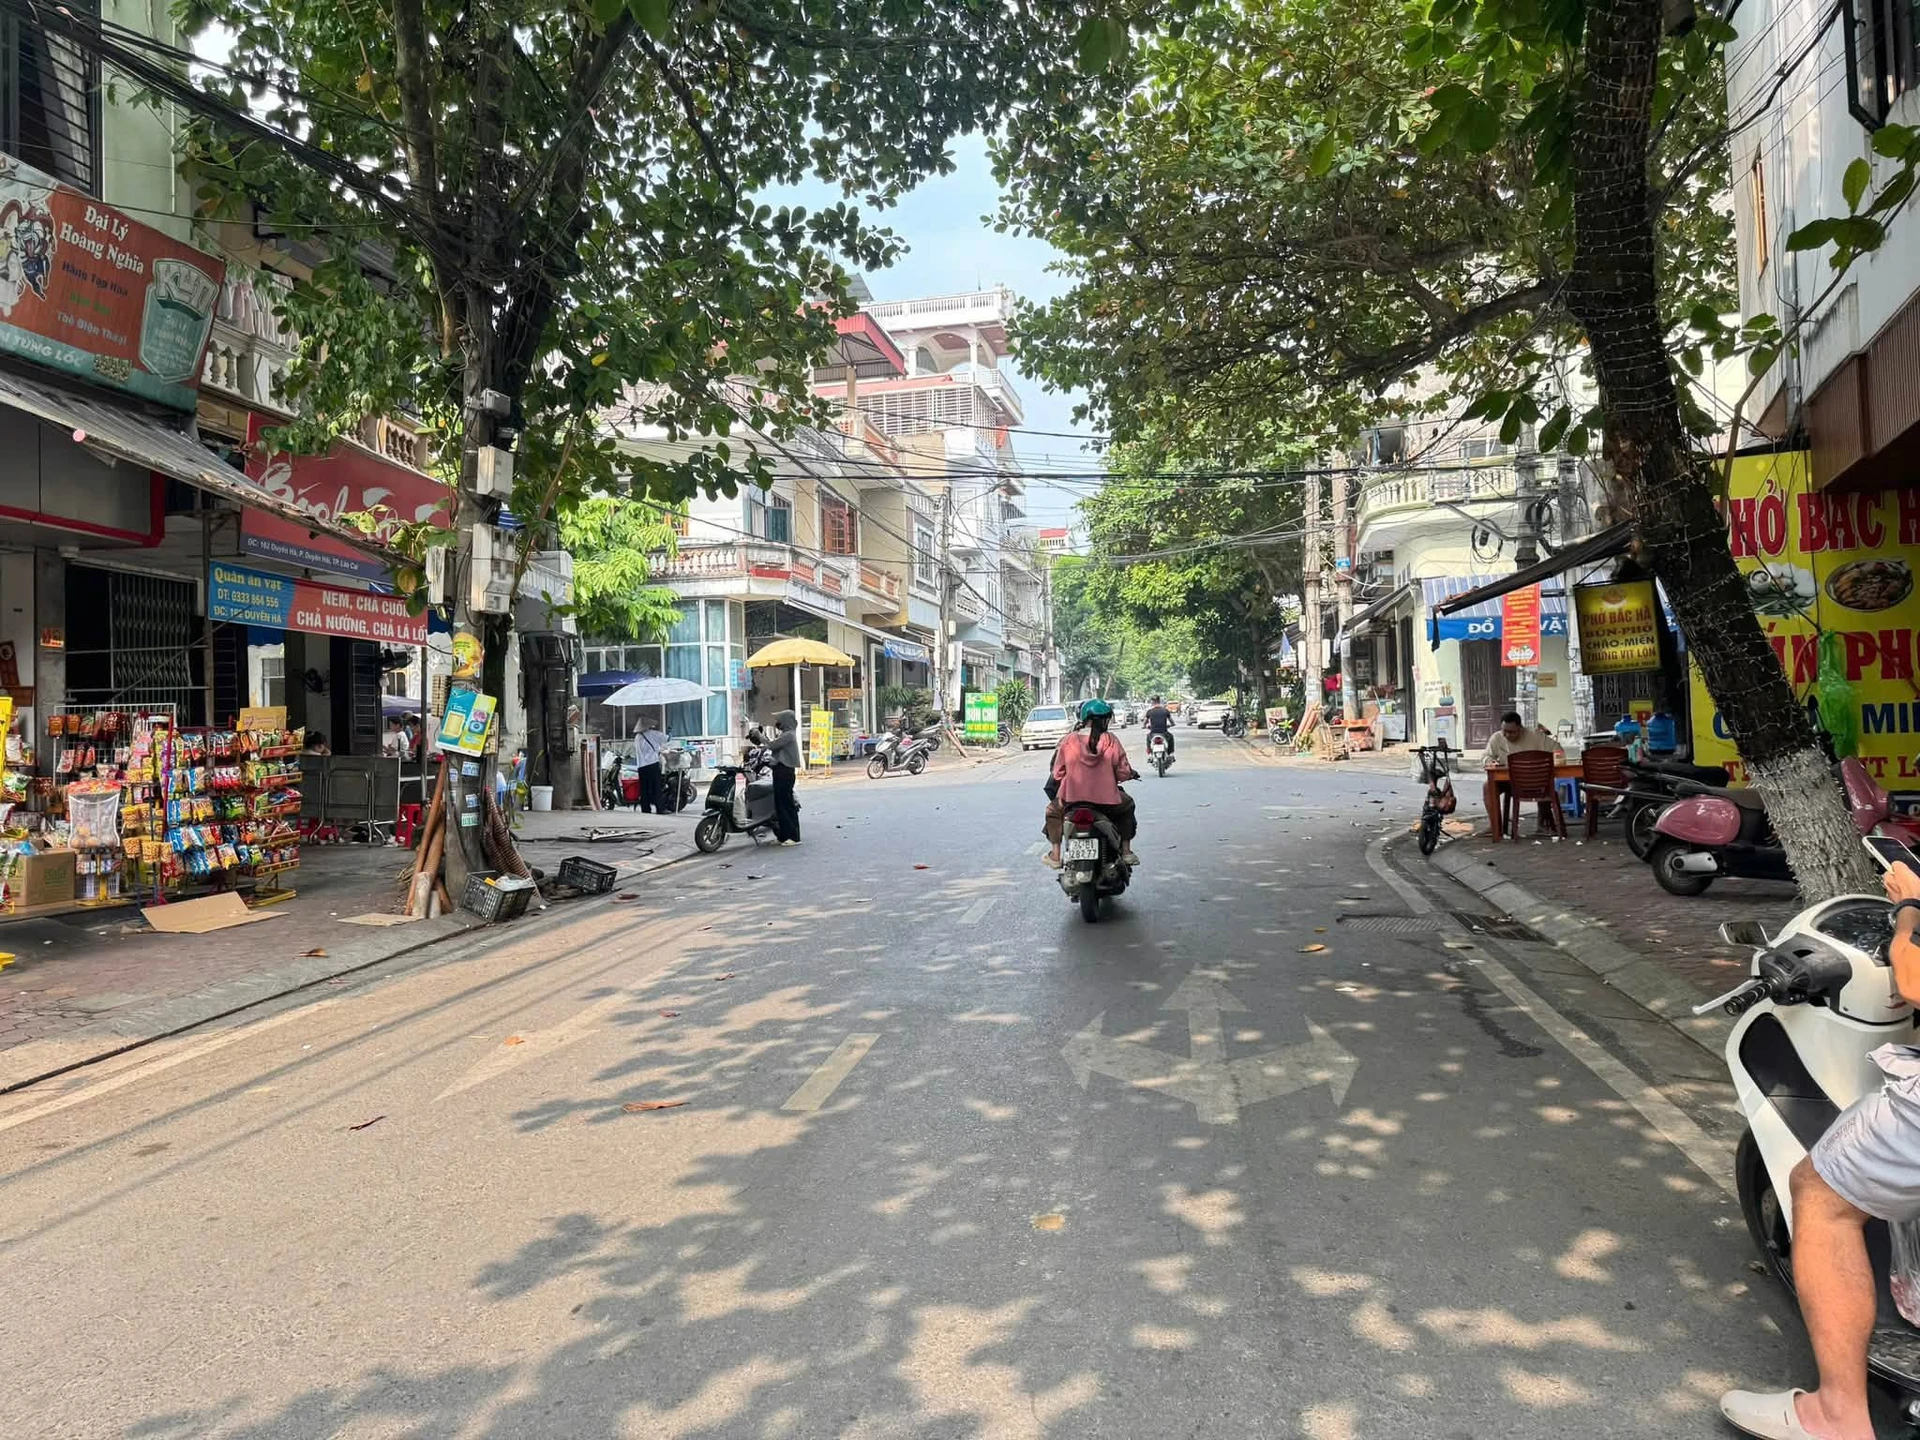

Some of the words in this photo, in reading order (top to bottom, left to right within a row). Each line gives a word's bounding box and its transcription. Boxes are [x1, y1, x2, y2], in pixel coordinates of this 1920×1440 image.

[84, 205, 109, 232] Đại
[112, 218, 129, 242] Lý
[60, 221, 104, 261] Hoàng
[106, 243, 144, 275] Nghĩa
[1714, 479, 1787, 559] HỞ
[296, 607, 322, 628] CHẢ
[325, 613, 369, 636] NƯỚNG,
[1468, 618, 1495, 633] ĐỒ
